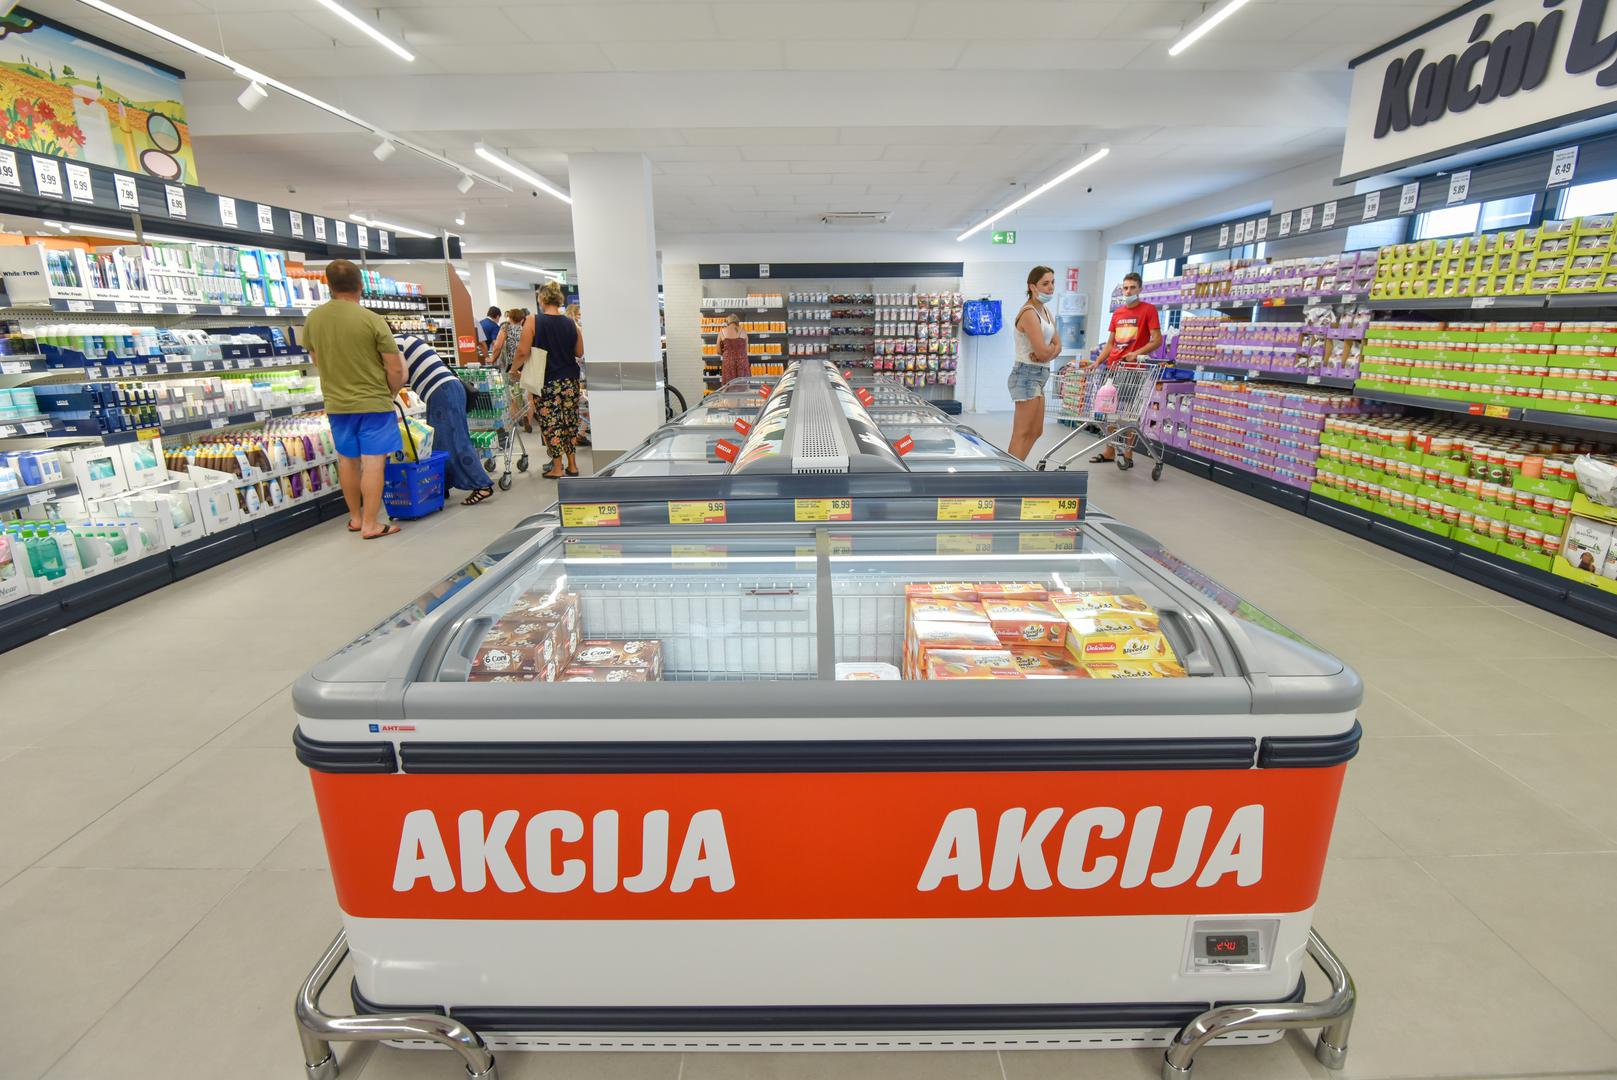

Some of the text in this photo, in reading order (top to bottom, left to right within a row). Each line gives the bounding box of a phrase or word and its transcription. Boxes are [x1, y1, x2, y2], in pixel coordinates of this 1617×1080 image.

[1374, 2, 1566, 139] Kućni
[1555, 163, 1571, 175] 6.49
[40, 174, 57, 185] 9.99
[73, 179, 88, 191] 6.99
[121, 188, 134, 199] 7.99
[485, 655, 491, 663] 6
[393, 810, 735, 892] AKCIJA
[918, 805, 1264, 891] AKCIJA
